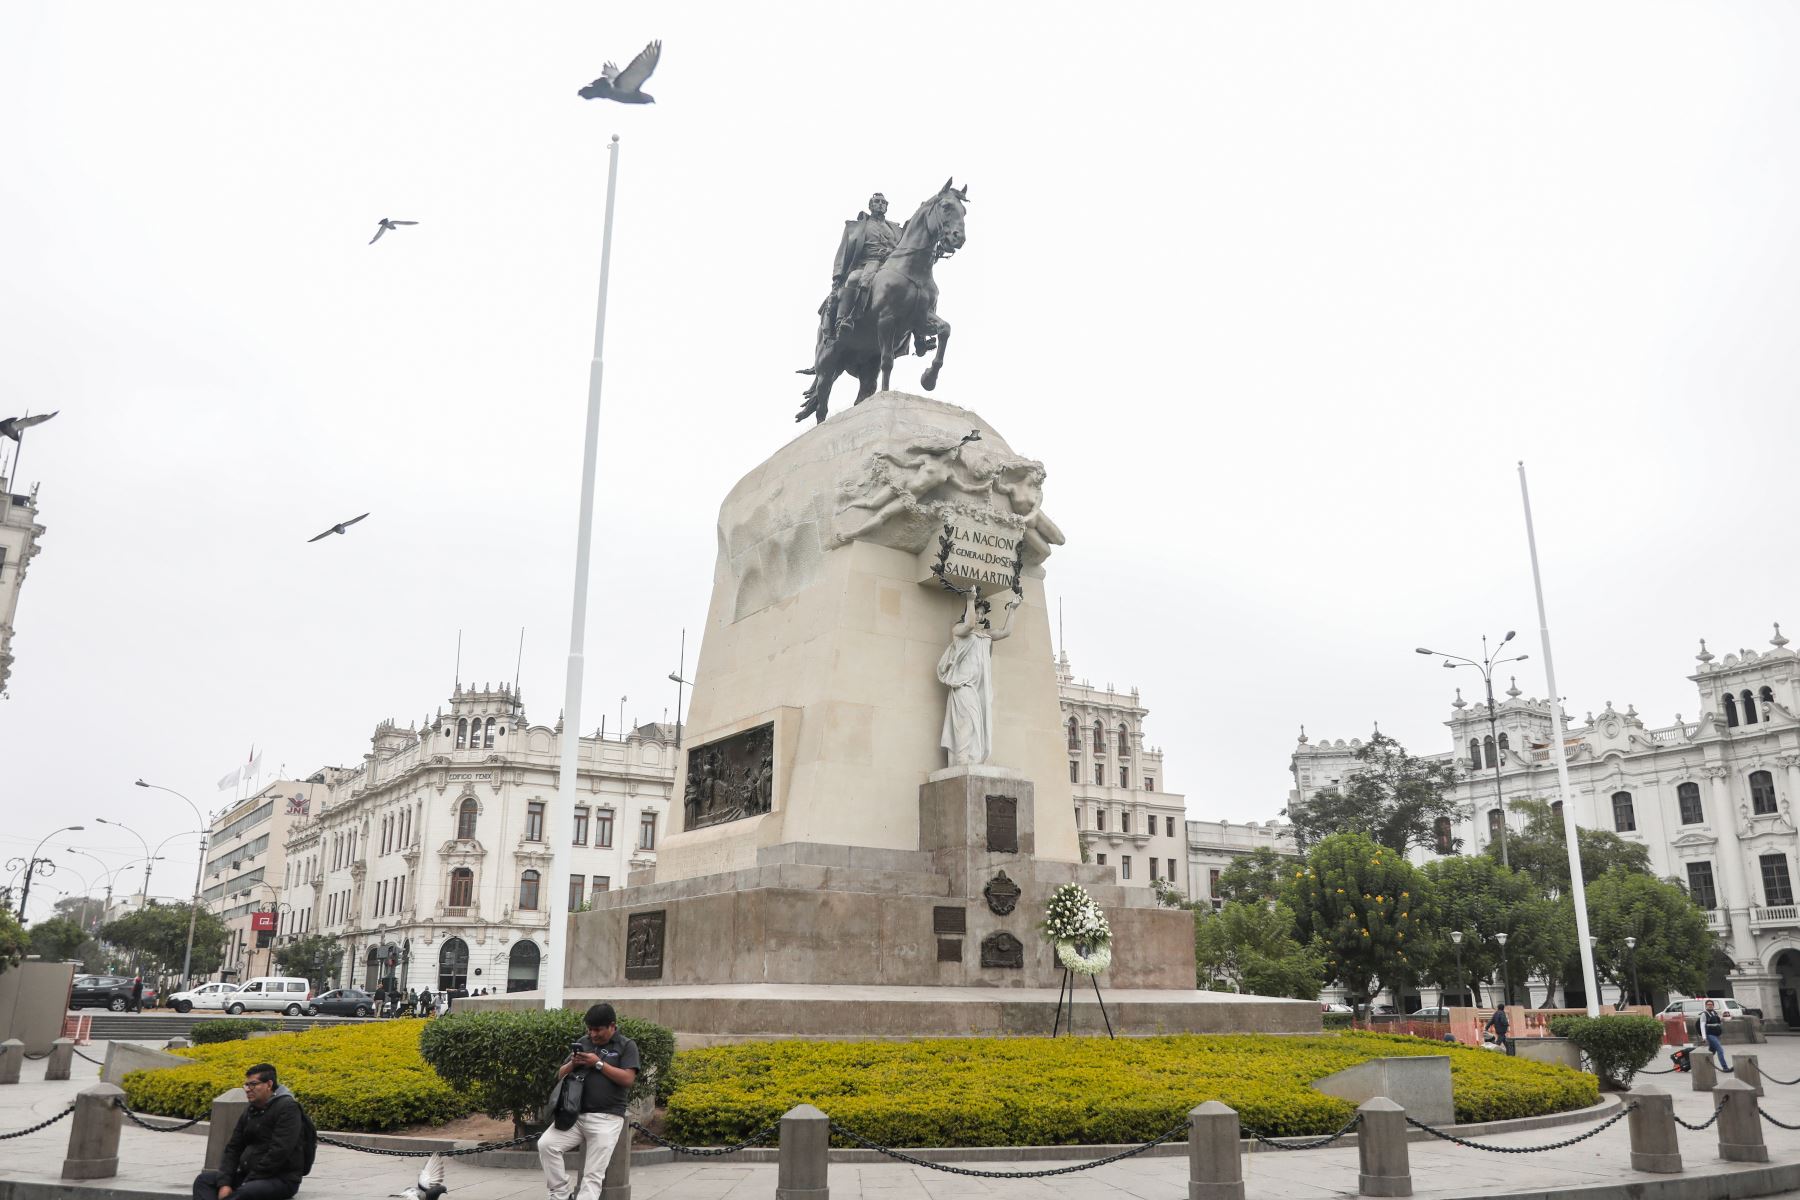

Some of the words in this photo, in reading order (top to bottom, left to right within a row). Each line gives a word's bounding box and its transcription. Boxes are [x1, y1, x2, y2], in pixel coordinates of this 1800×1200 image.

[954, 527, 969, 541] LA
[973, 532, 1014, 550] NACION
[956, 548, 985, 560] GENERAL
[944, 562, 968, 576] SAN
[968, 567, 1012, 585] MARTIN
